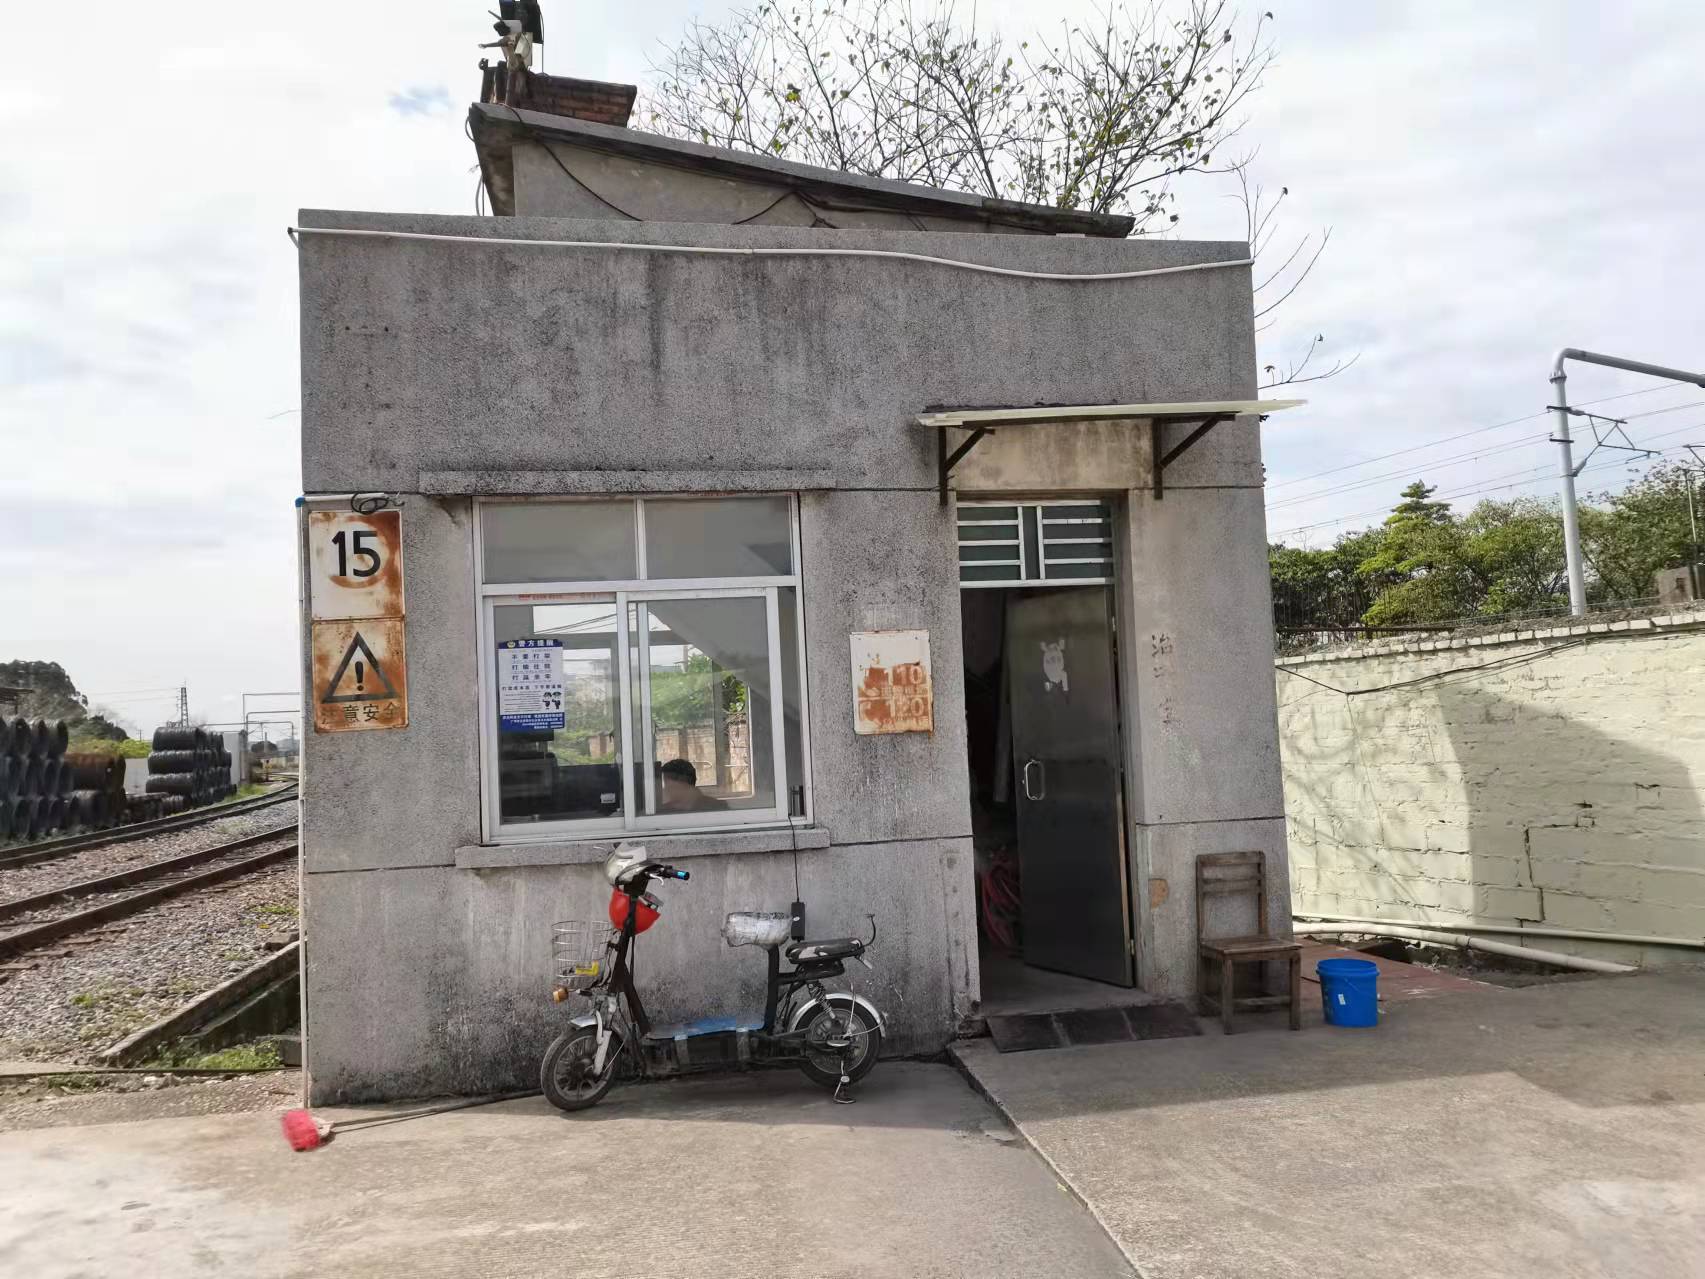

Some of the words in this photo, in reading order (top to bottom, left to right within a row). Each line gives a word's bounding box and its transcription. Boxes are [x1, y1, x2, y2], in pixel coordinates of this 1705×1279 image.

[331, 530, 381, 577] 15
[320, 702, 401, 725] 意安全
